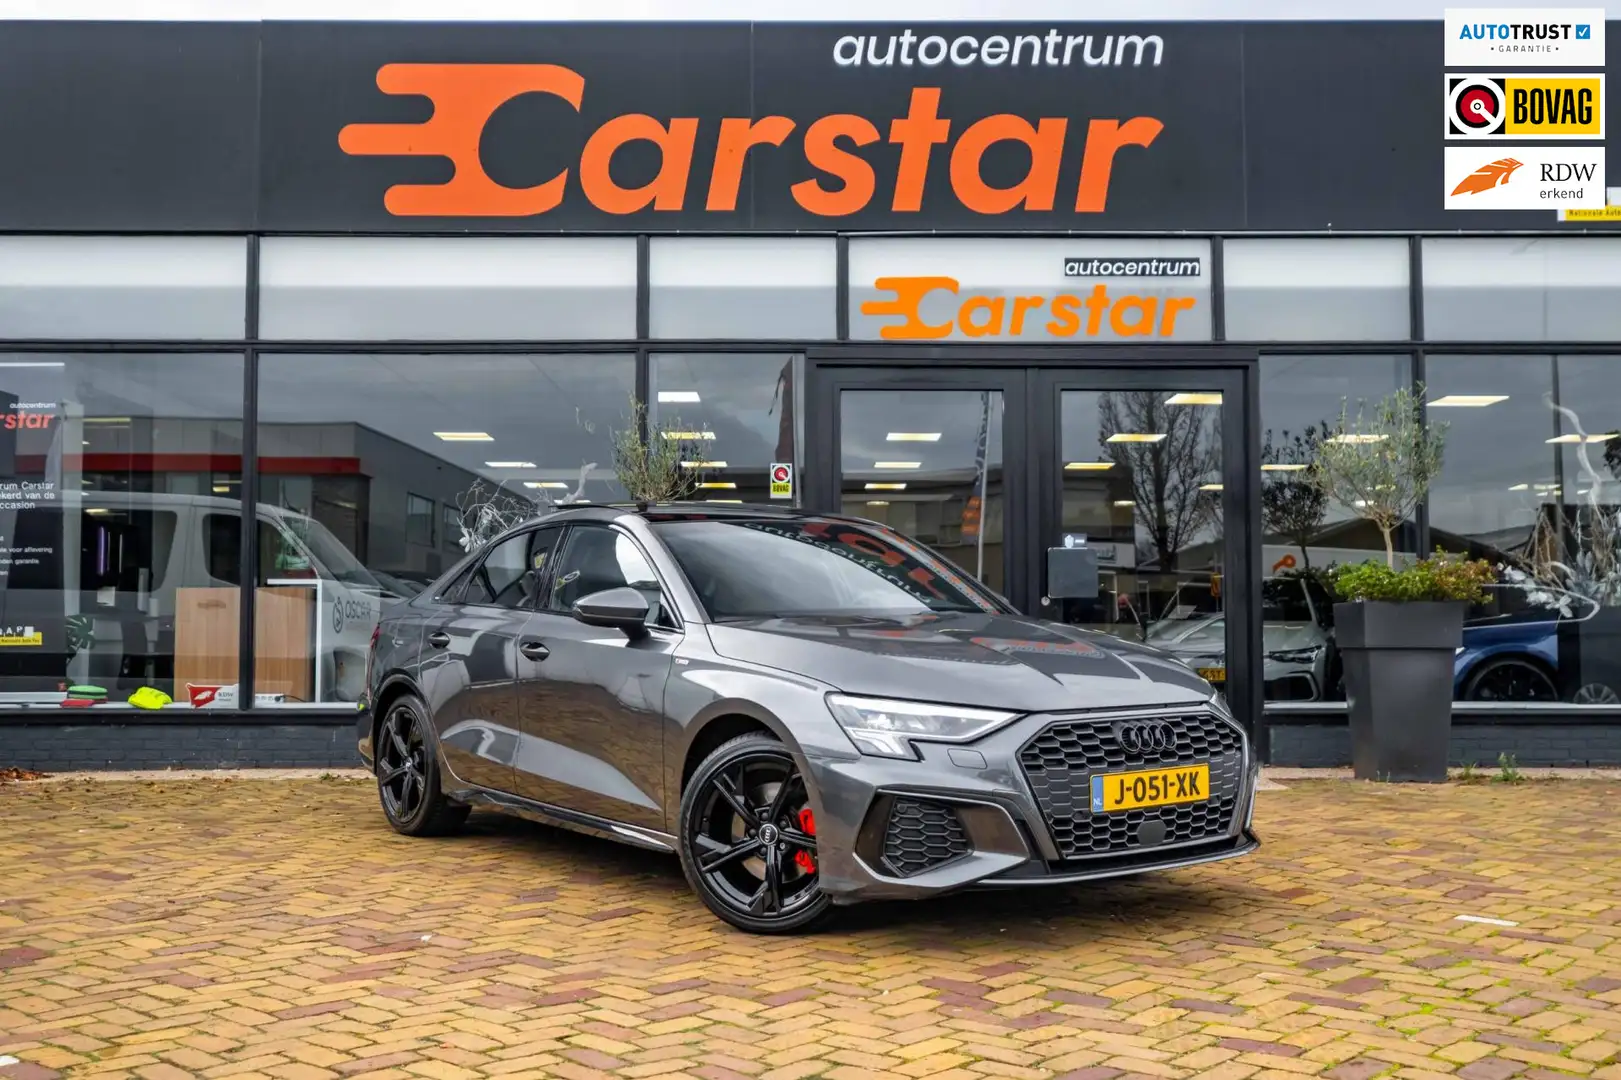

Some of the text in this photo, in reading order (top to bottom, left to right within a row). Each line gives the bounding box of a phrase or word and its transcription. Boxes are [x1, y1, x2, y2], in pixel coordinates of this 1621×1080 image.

[832, 28, 1165, 67] autocentrum
[338, 63, 1165, 217] Carstar
[1066, 259, 1199, 275] autocentrum
[861, 276, 1196, 341] Carstar
[21, 481, 54, 491] Carstar
[25, 492, 41, 500] van
[44, 491, 55, 500] de
[1114, 771, 1201, 805] J-051-XK
